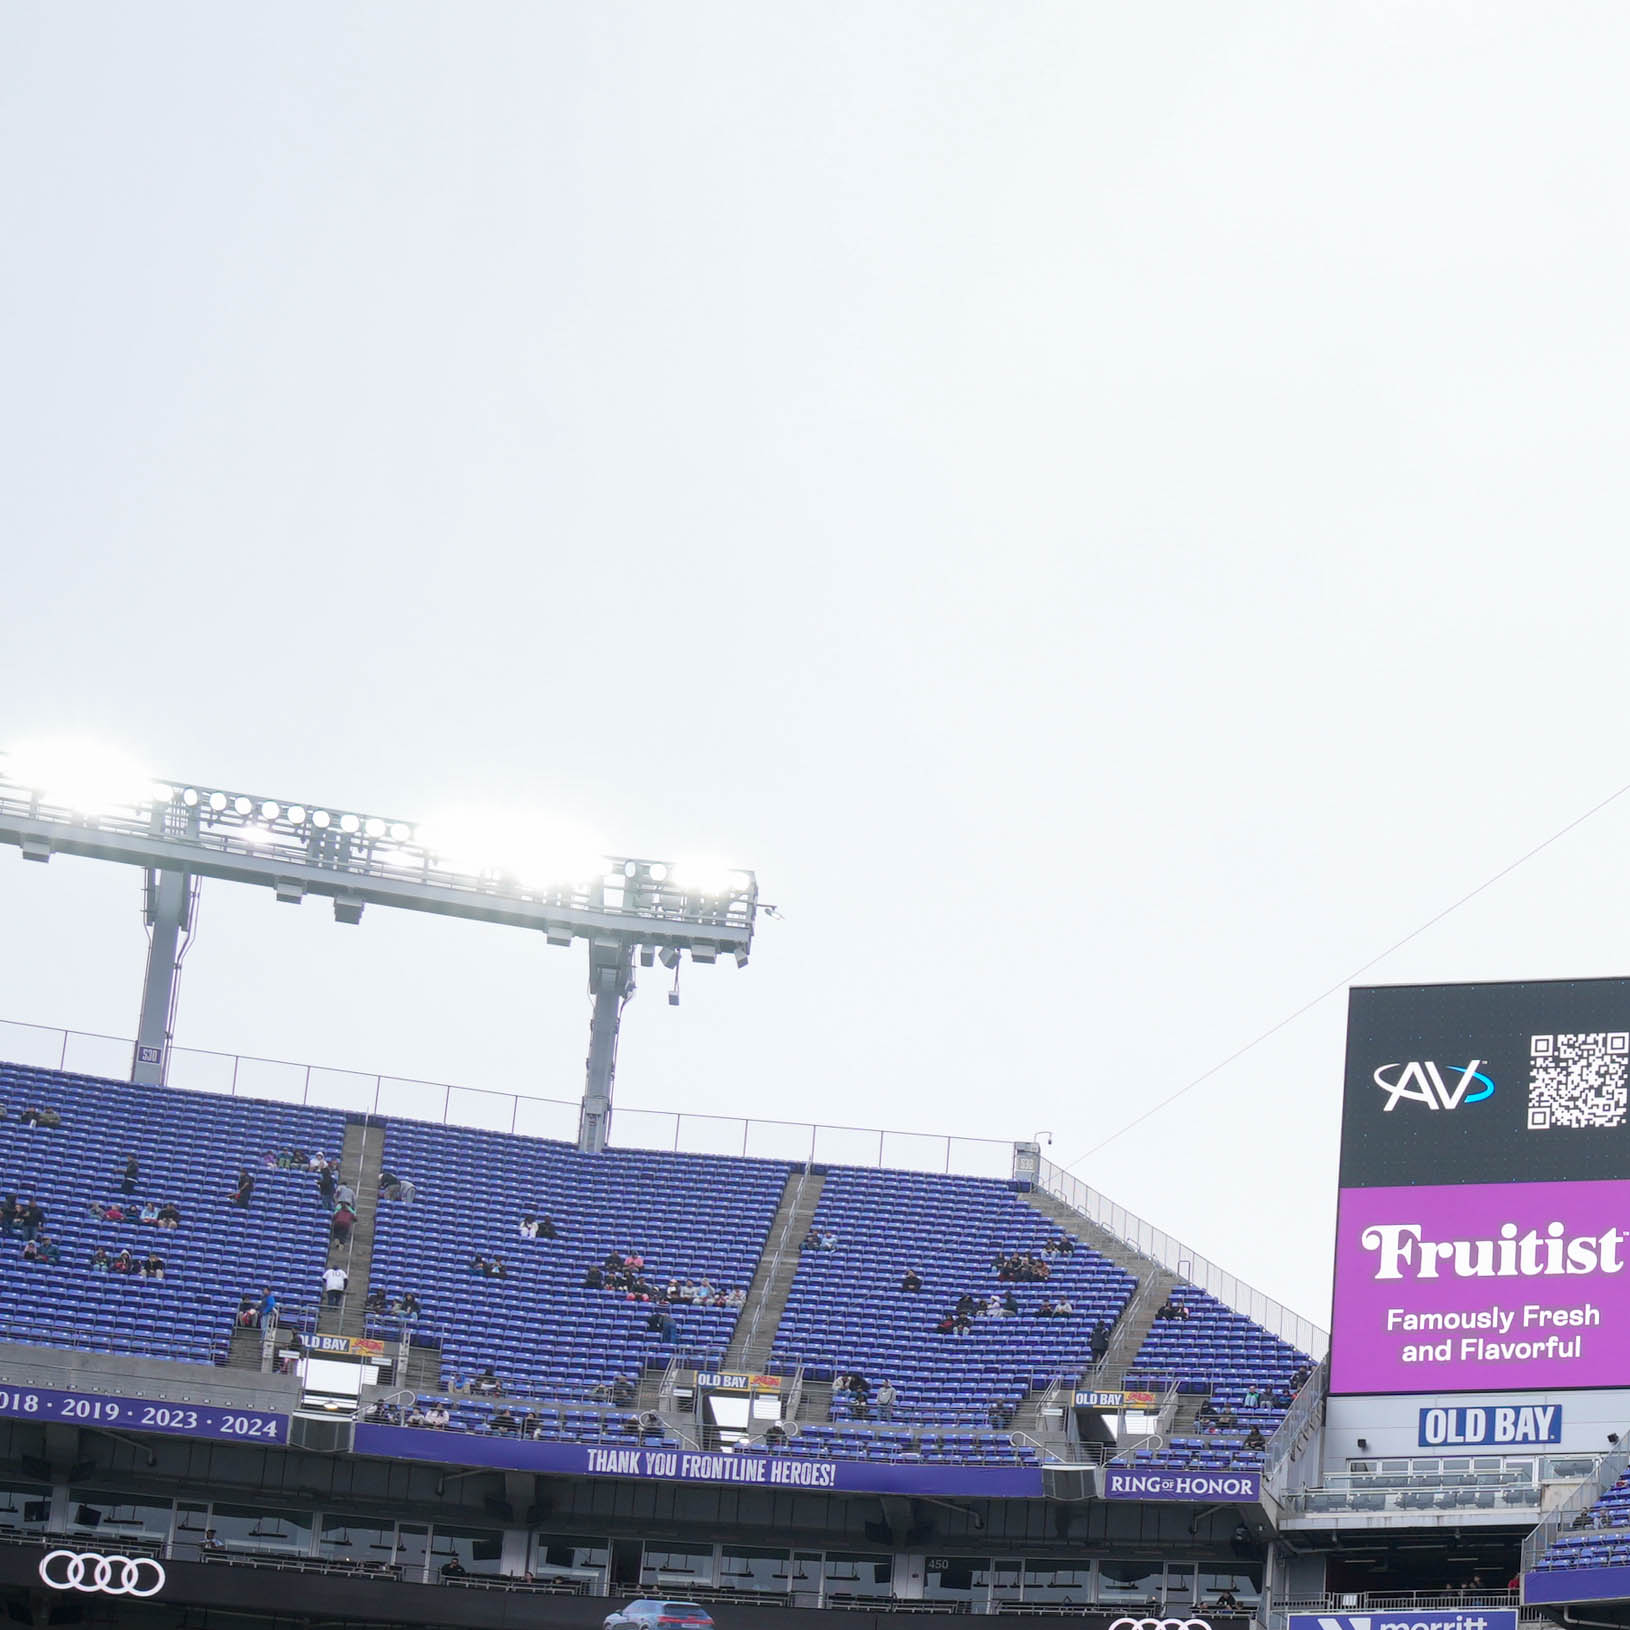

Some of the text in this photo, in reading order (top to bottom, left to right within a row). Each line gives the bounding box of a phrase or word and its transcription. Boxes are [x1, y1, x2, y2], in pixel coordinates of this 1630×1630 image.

[1387, 1303, 1601, 1334] Famously Fresh
[323, 1336, 348, 1352] BAY
[1402, 1336, 1582, 1363] and Flavorful
[698, 1373, 746, 1388] OLD BAY
[1076, 1392, 1122, 1406] OLD BAY
[61, 1398, 278, 1437] 2019 2023 2024
[1425, 1406, 1555, 1444] OLD BAY
[587, 1449, 836, 1487] THANK YOU FRONTLINE HEROES!
[1111, 1475, 1253, 1495] RING OF HONOR
[927, 1558, 949, 1570] 450
